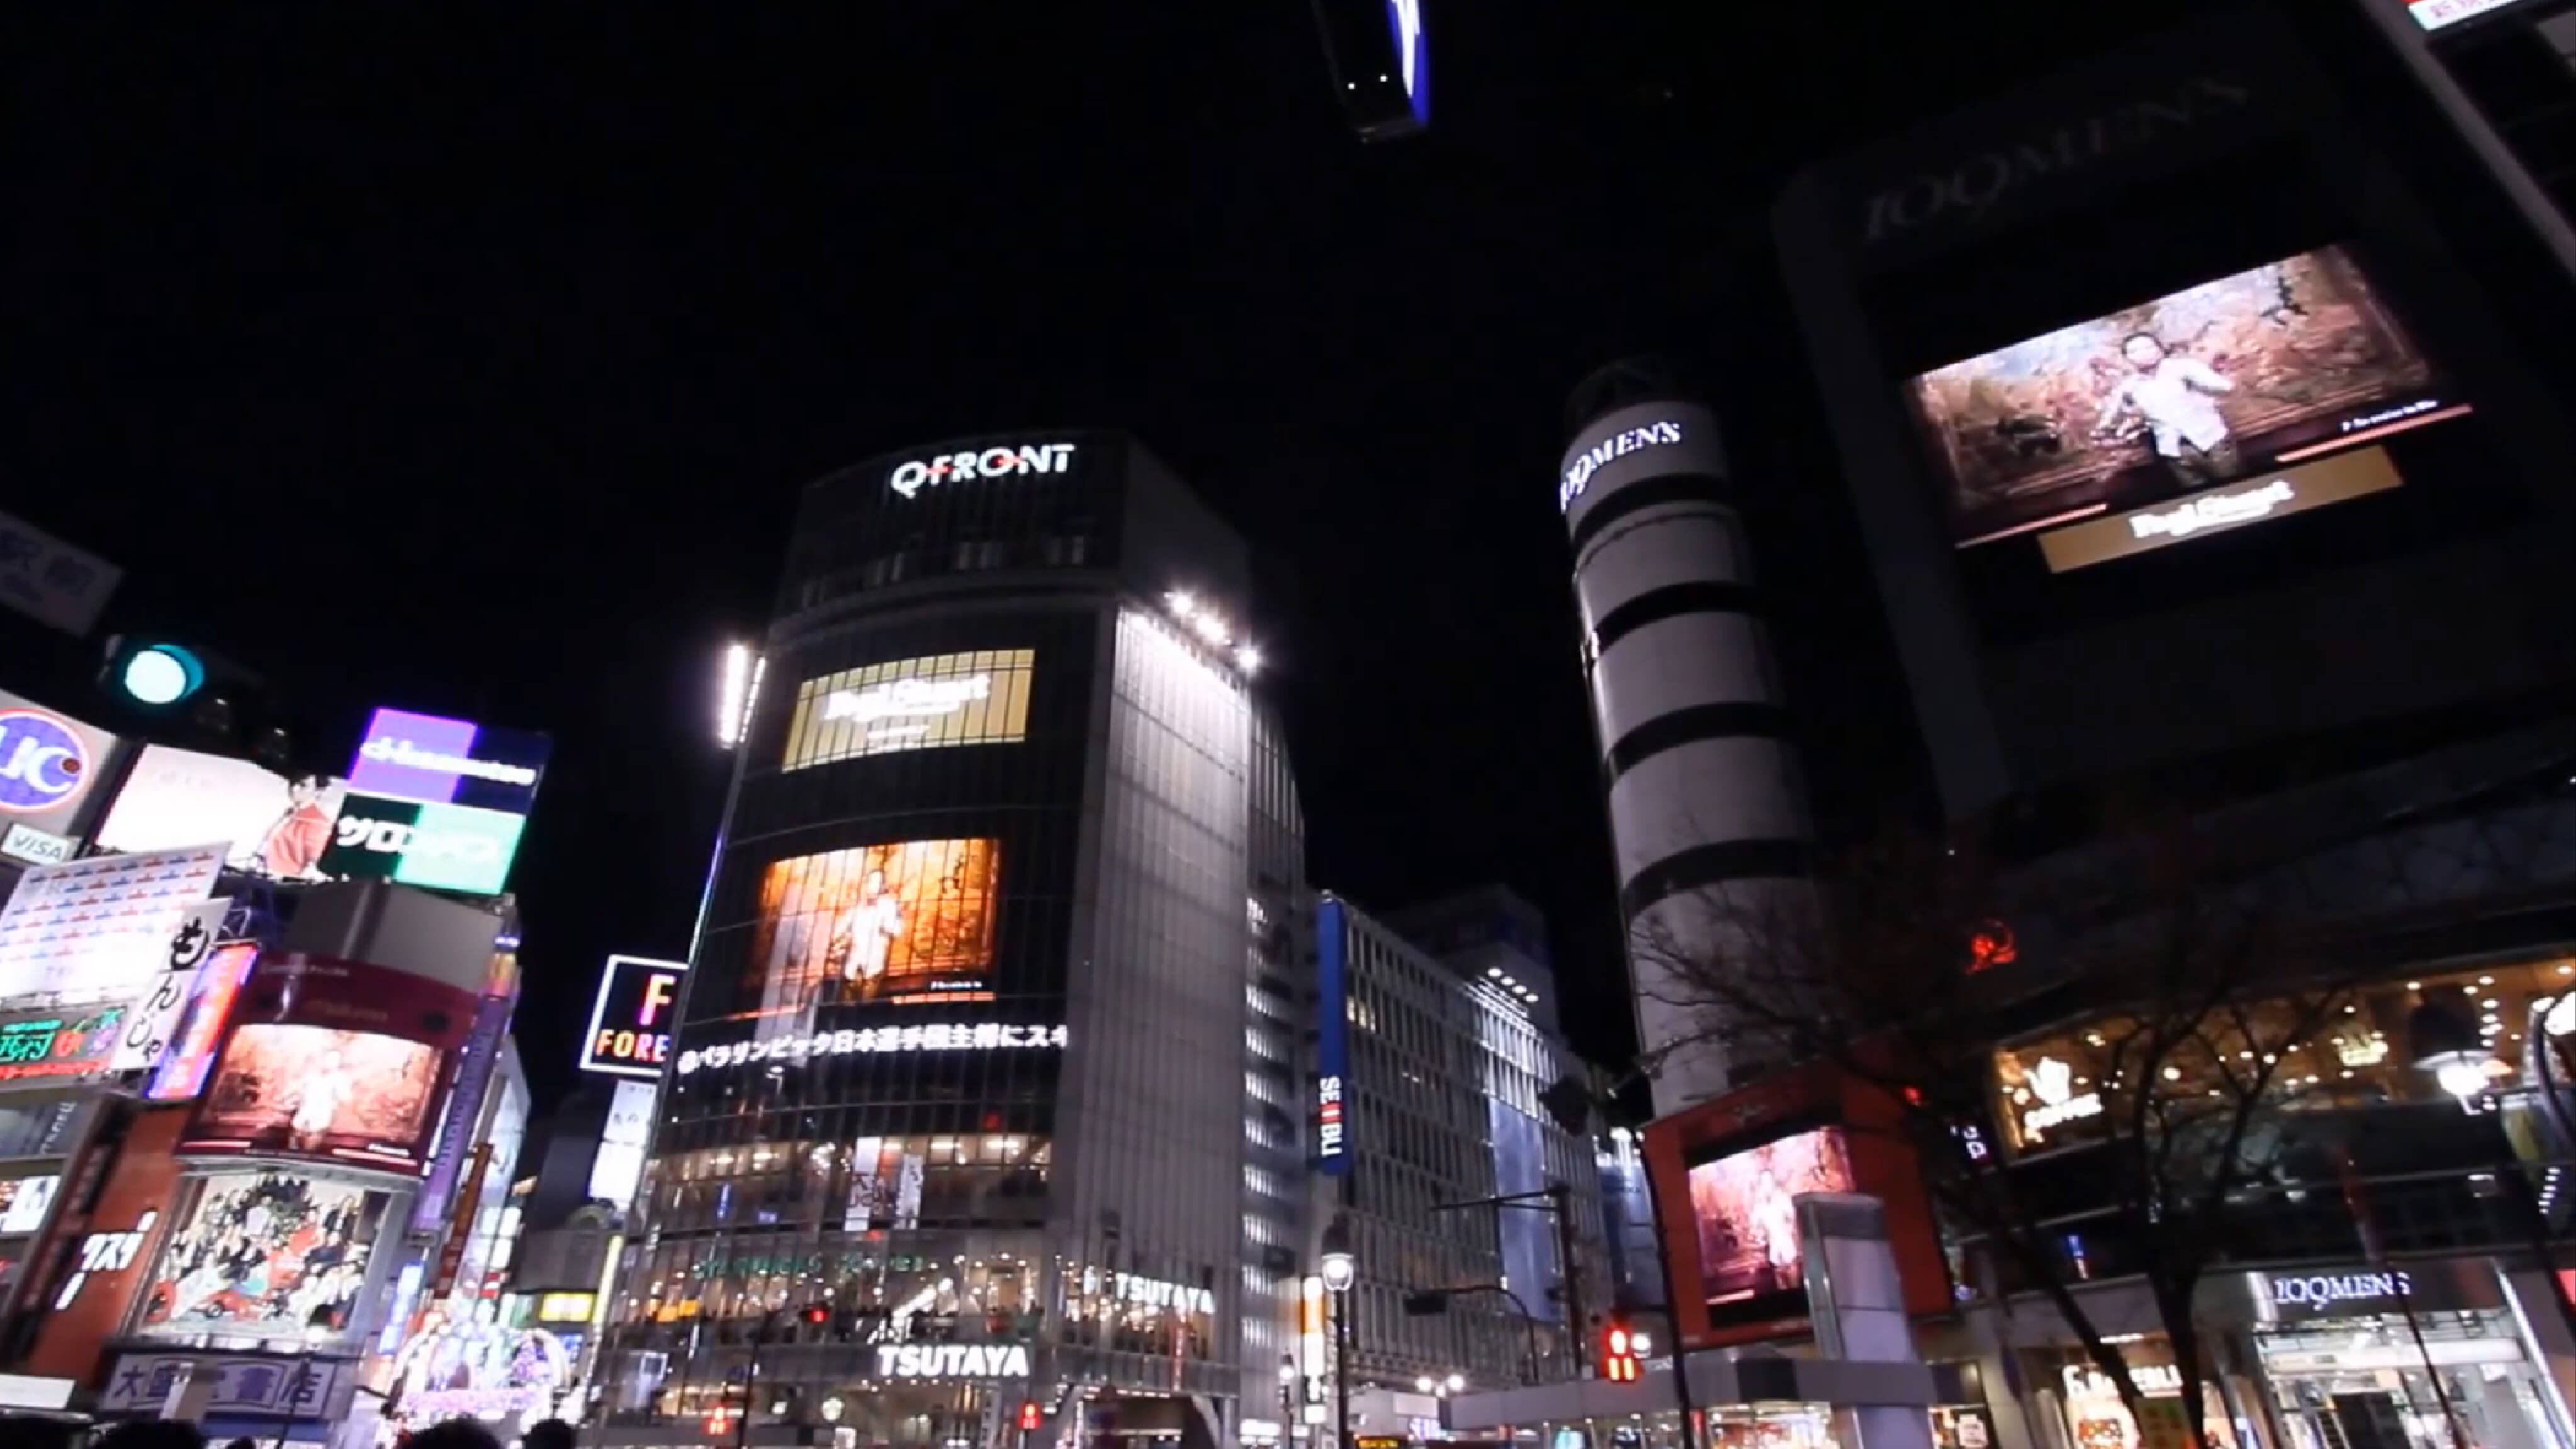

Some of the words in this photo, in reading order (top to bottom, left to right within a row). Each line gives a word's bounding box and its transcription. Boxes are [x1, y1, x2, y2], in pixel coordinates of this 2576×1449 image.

[891, 443, 1076, 499] QFRONT
[13, 833, 62, 858] VISA
[595, 1028, 672, 1063] FORE
[1320, 1076, 1343, 1158] SEIBU
[1115, 1272, 1215, 1316] TSUTAYA
[877, 1345, 1030, 1377] TSUTAYA
